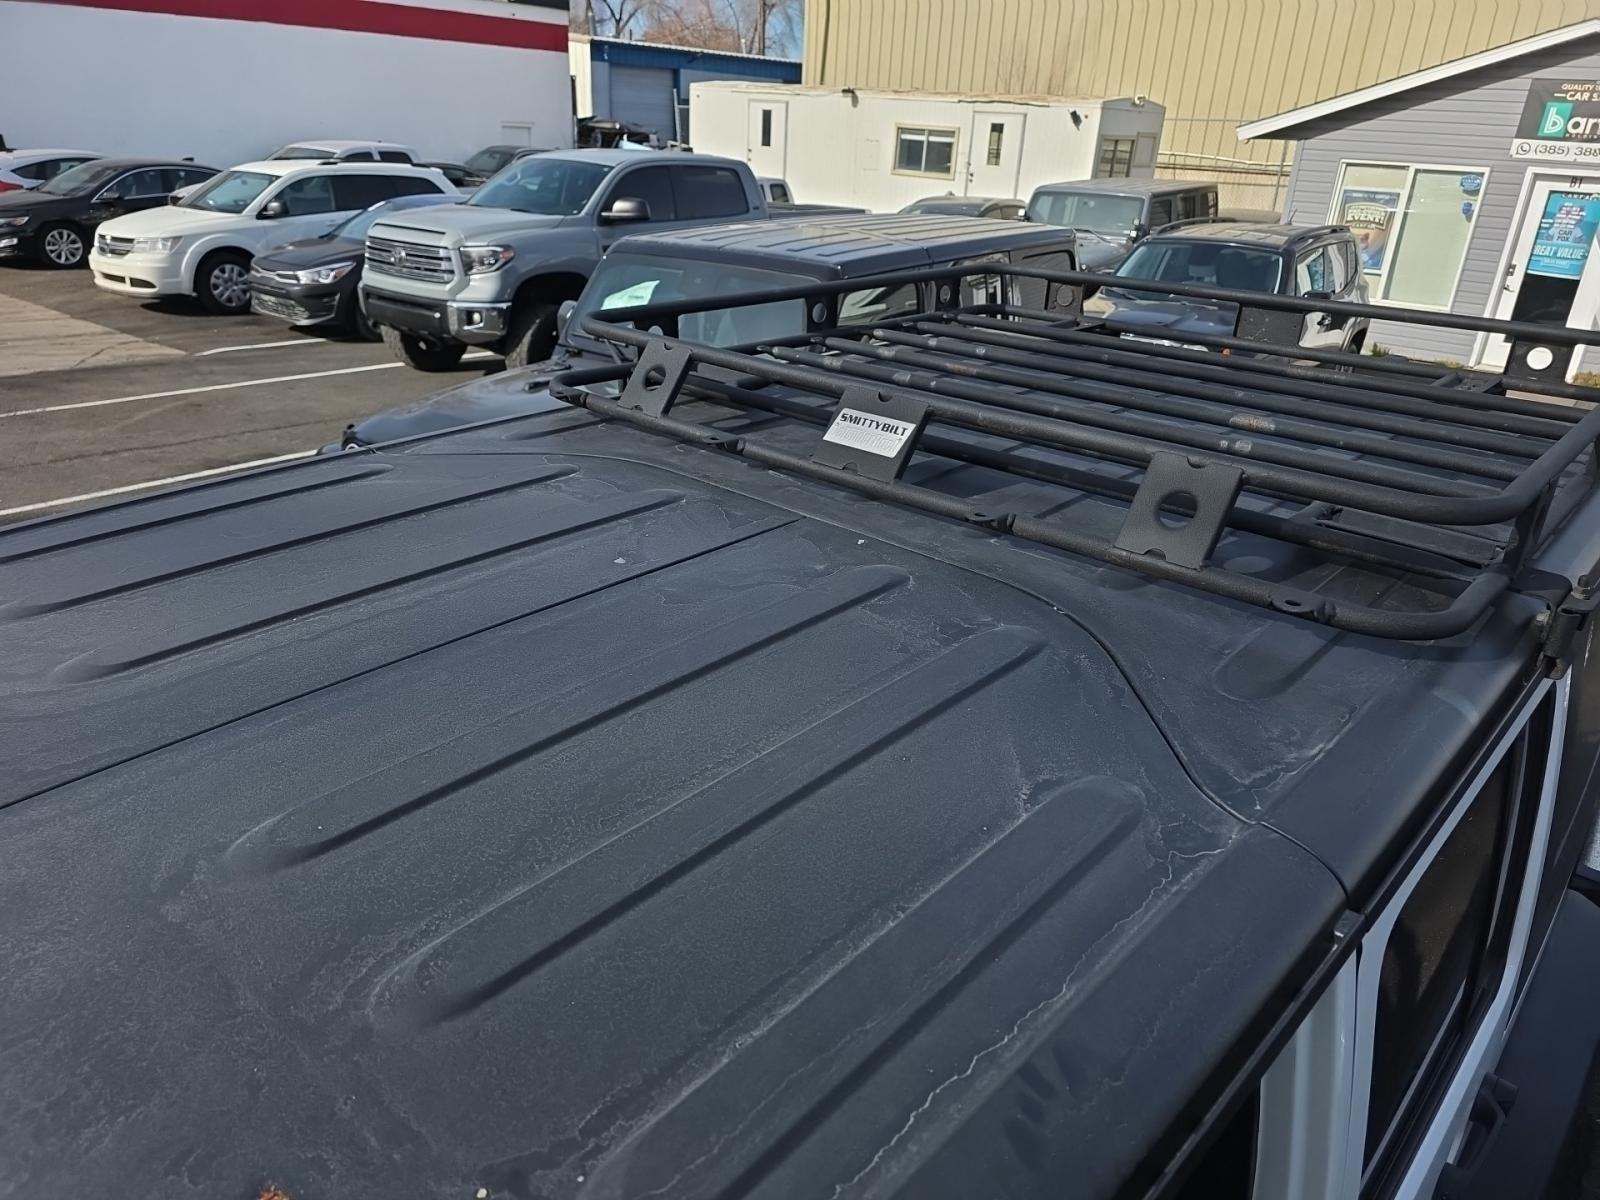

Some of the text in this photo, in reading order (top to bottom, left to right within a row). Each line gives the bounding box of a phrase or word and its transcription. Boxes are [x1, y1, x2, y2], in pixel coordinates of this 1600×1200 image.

[1566, 91, 1590, 101] CAR
[1534, 144, 1570, 156] (385)
[840, 413, 908, 436] SMITTYBILT
